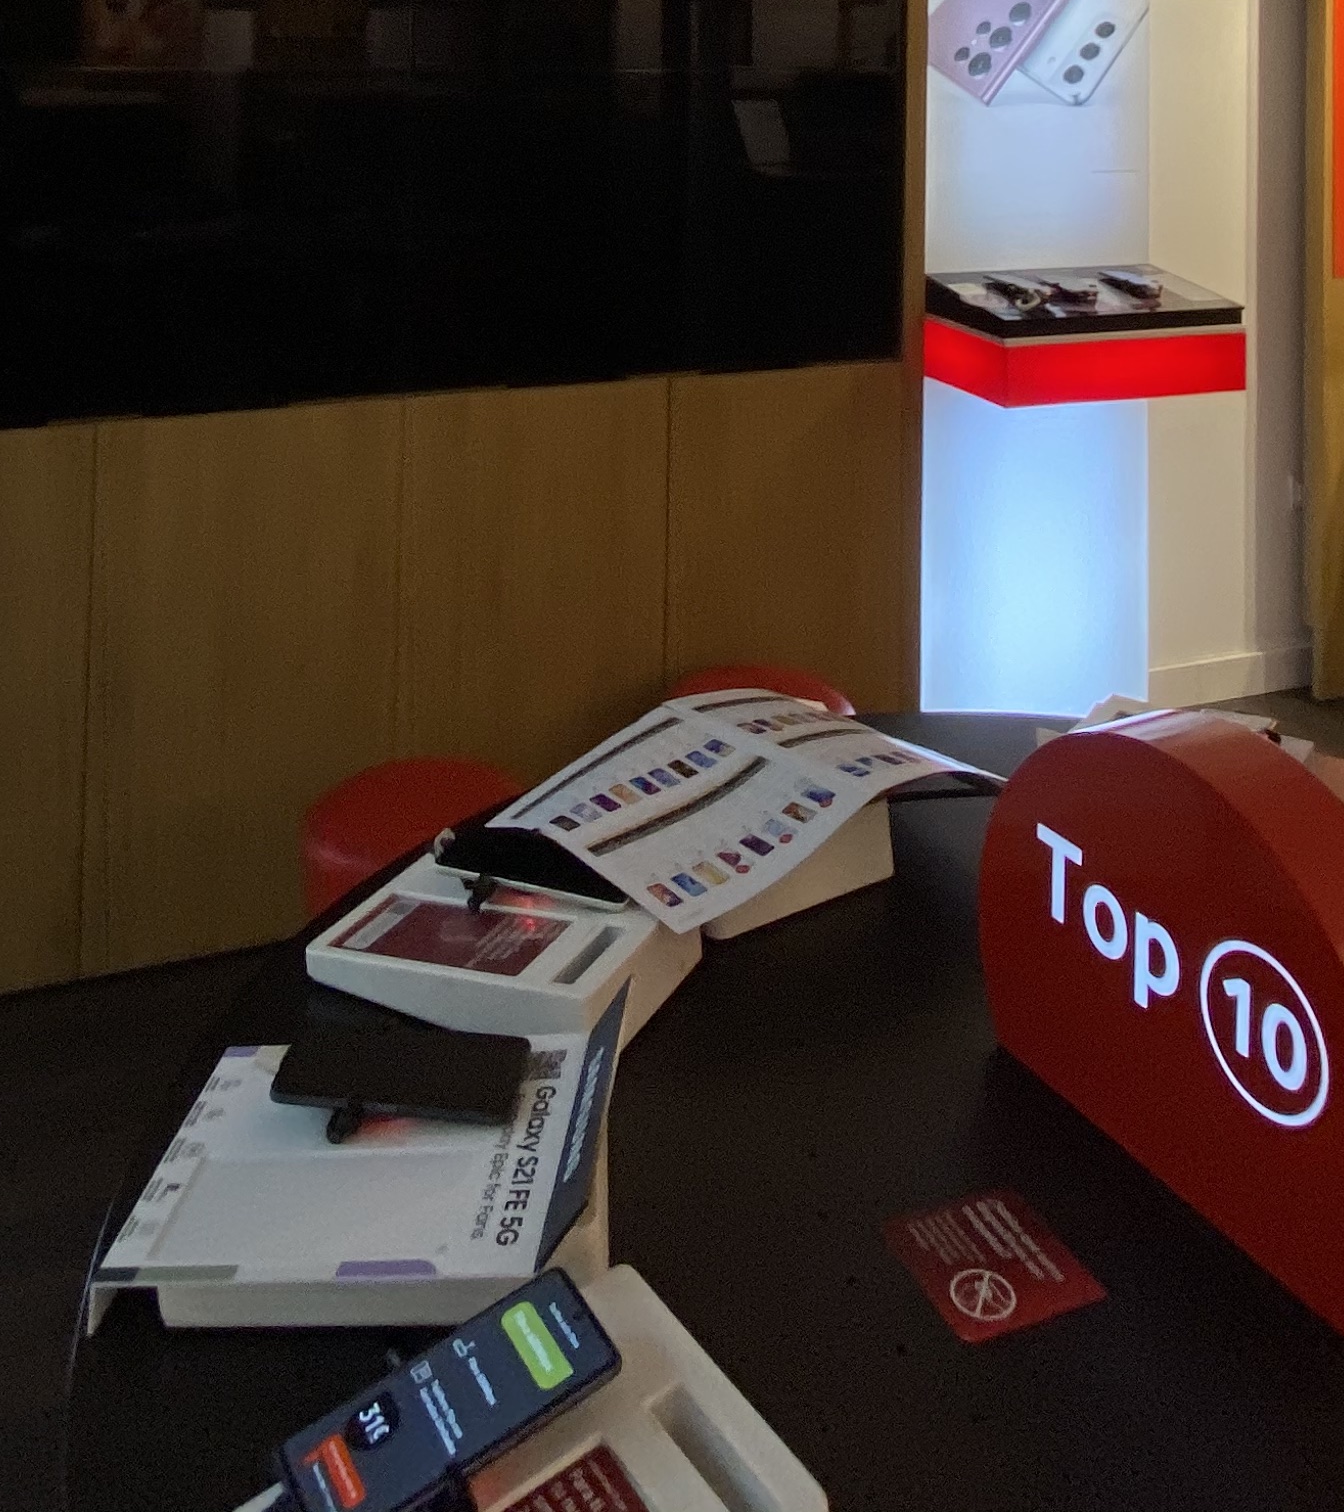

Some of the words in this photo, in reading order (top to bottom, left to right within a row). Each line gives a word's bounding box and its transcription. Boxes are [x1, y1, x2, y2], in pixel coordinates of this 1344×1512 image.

[1036, 823, 1180, 1009] Top
[1222, 977, 1308, 1092] 10
[516, 1086, 557, 1153] Galaxy
[511, 1156, 540, 1186] S21
[504, 1188, 531, 1212] FE
[495, 1216, 524, 1248] 5G
